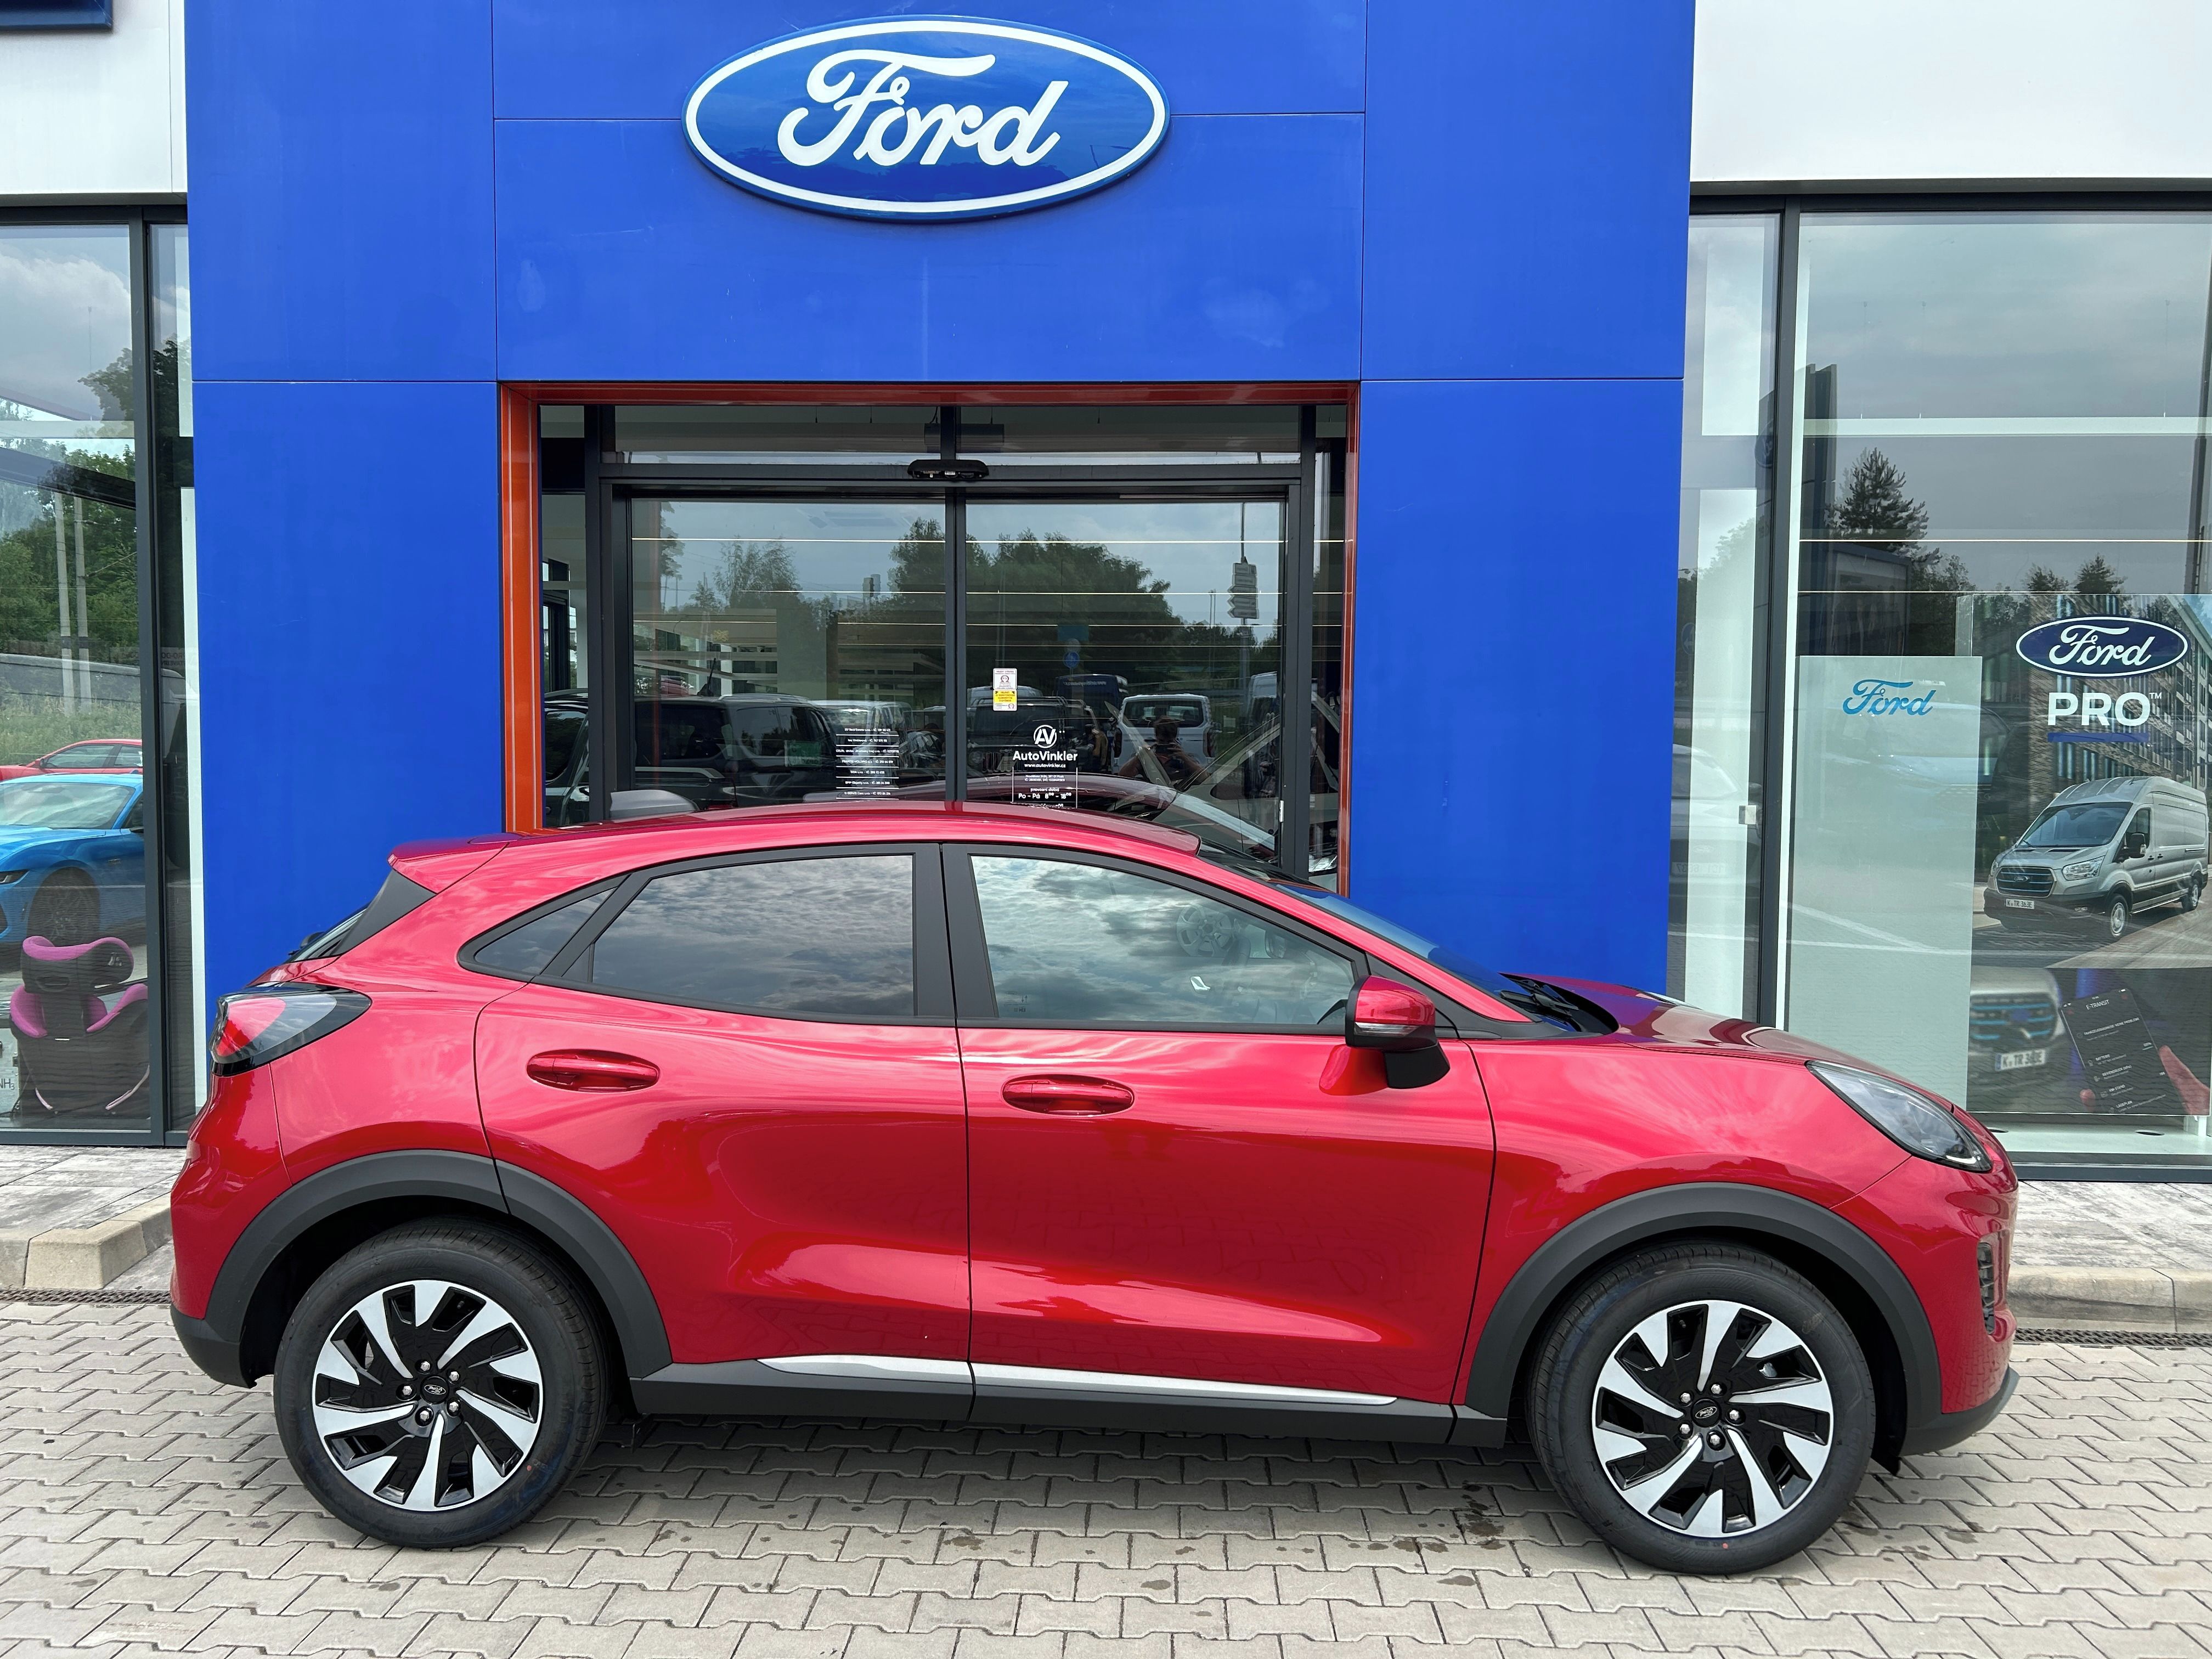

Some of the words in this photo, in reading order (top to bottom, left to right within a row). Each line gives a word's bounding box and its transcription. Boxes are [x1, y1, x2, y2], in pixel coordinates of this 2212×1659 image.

[777, 49, 1069, 166] Ford
[2048, 624, 2155, 667] Ford
[1843, 679, 1937, 716] Ford
[1012, 751, 1078, 761] AutoVinkler
